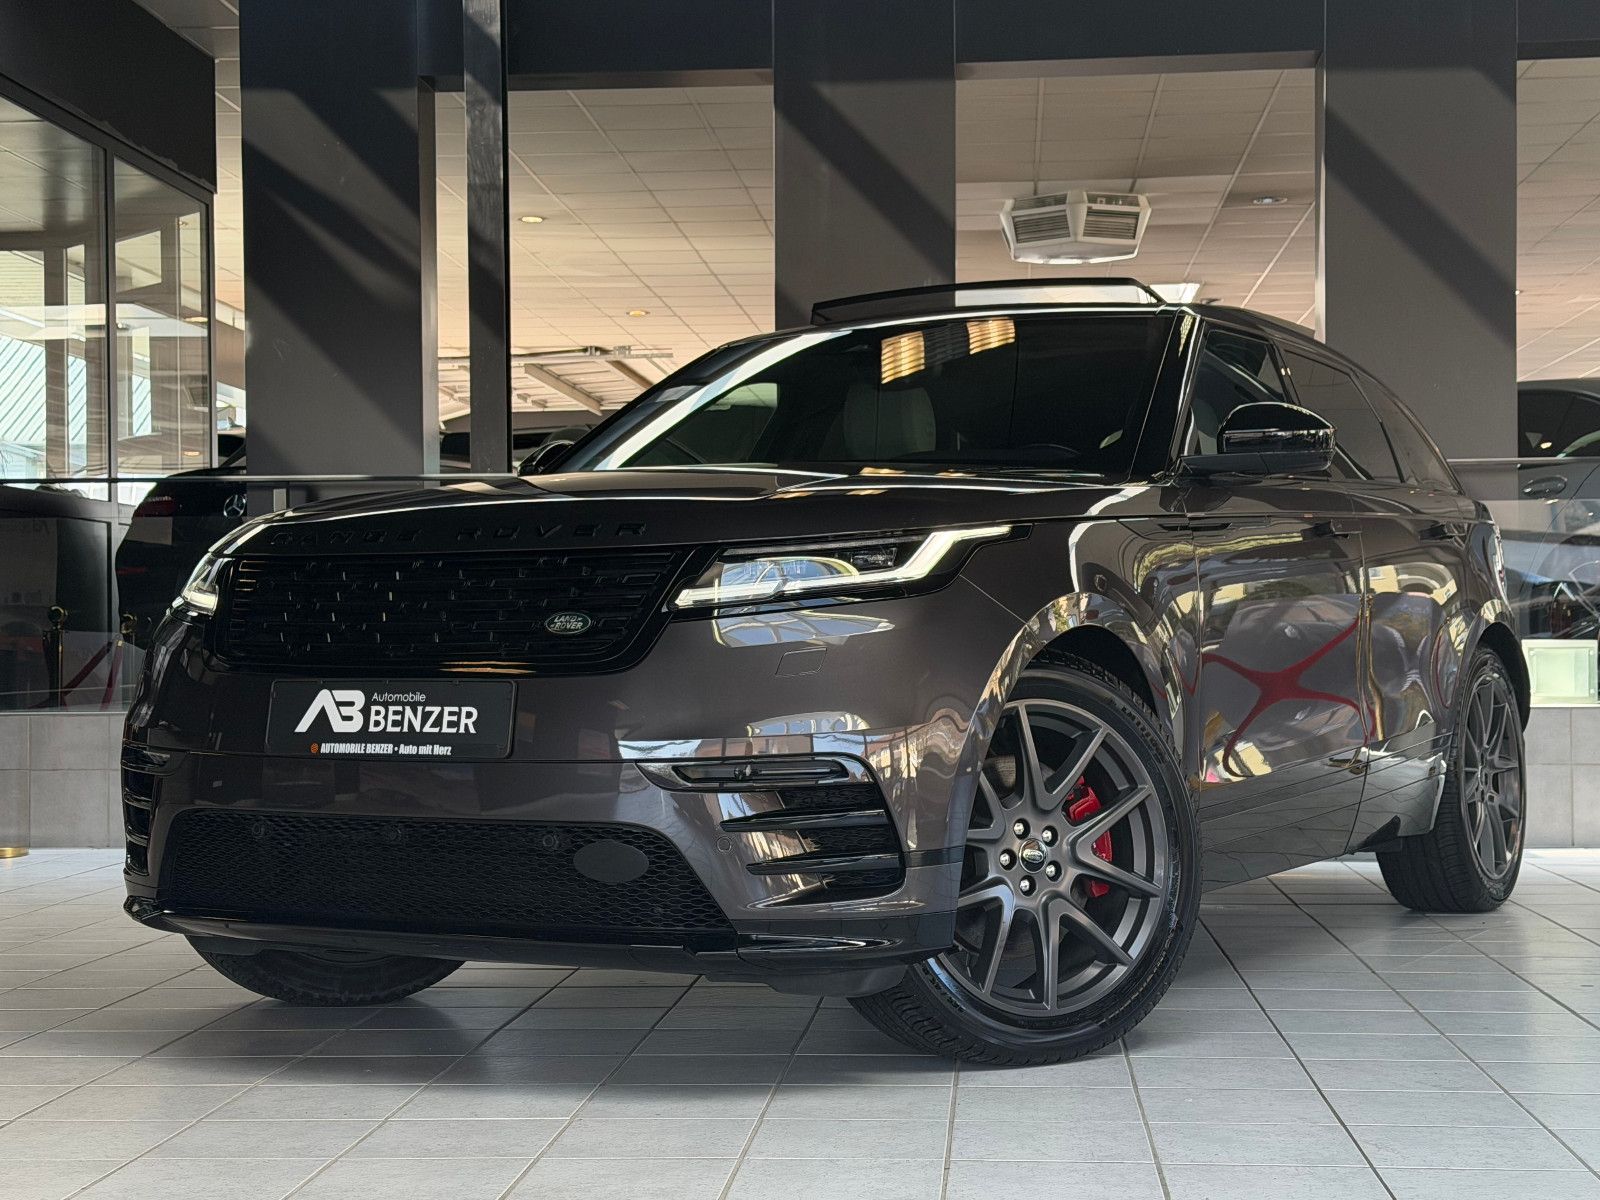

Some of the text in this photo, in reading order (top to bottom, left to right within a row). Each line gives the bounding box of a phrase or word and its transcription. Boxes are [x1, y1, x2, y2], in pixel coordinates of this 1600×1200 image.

[371, 692, 426, 702] Automobile
[368, 705, 478, 734] BENZER
[320, 743, 452, 756] AUTOMOBILE BENZER Auto mit Herz
